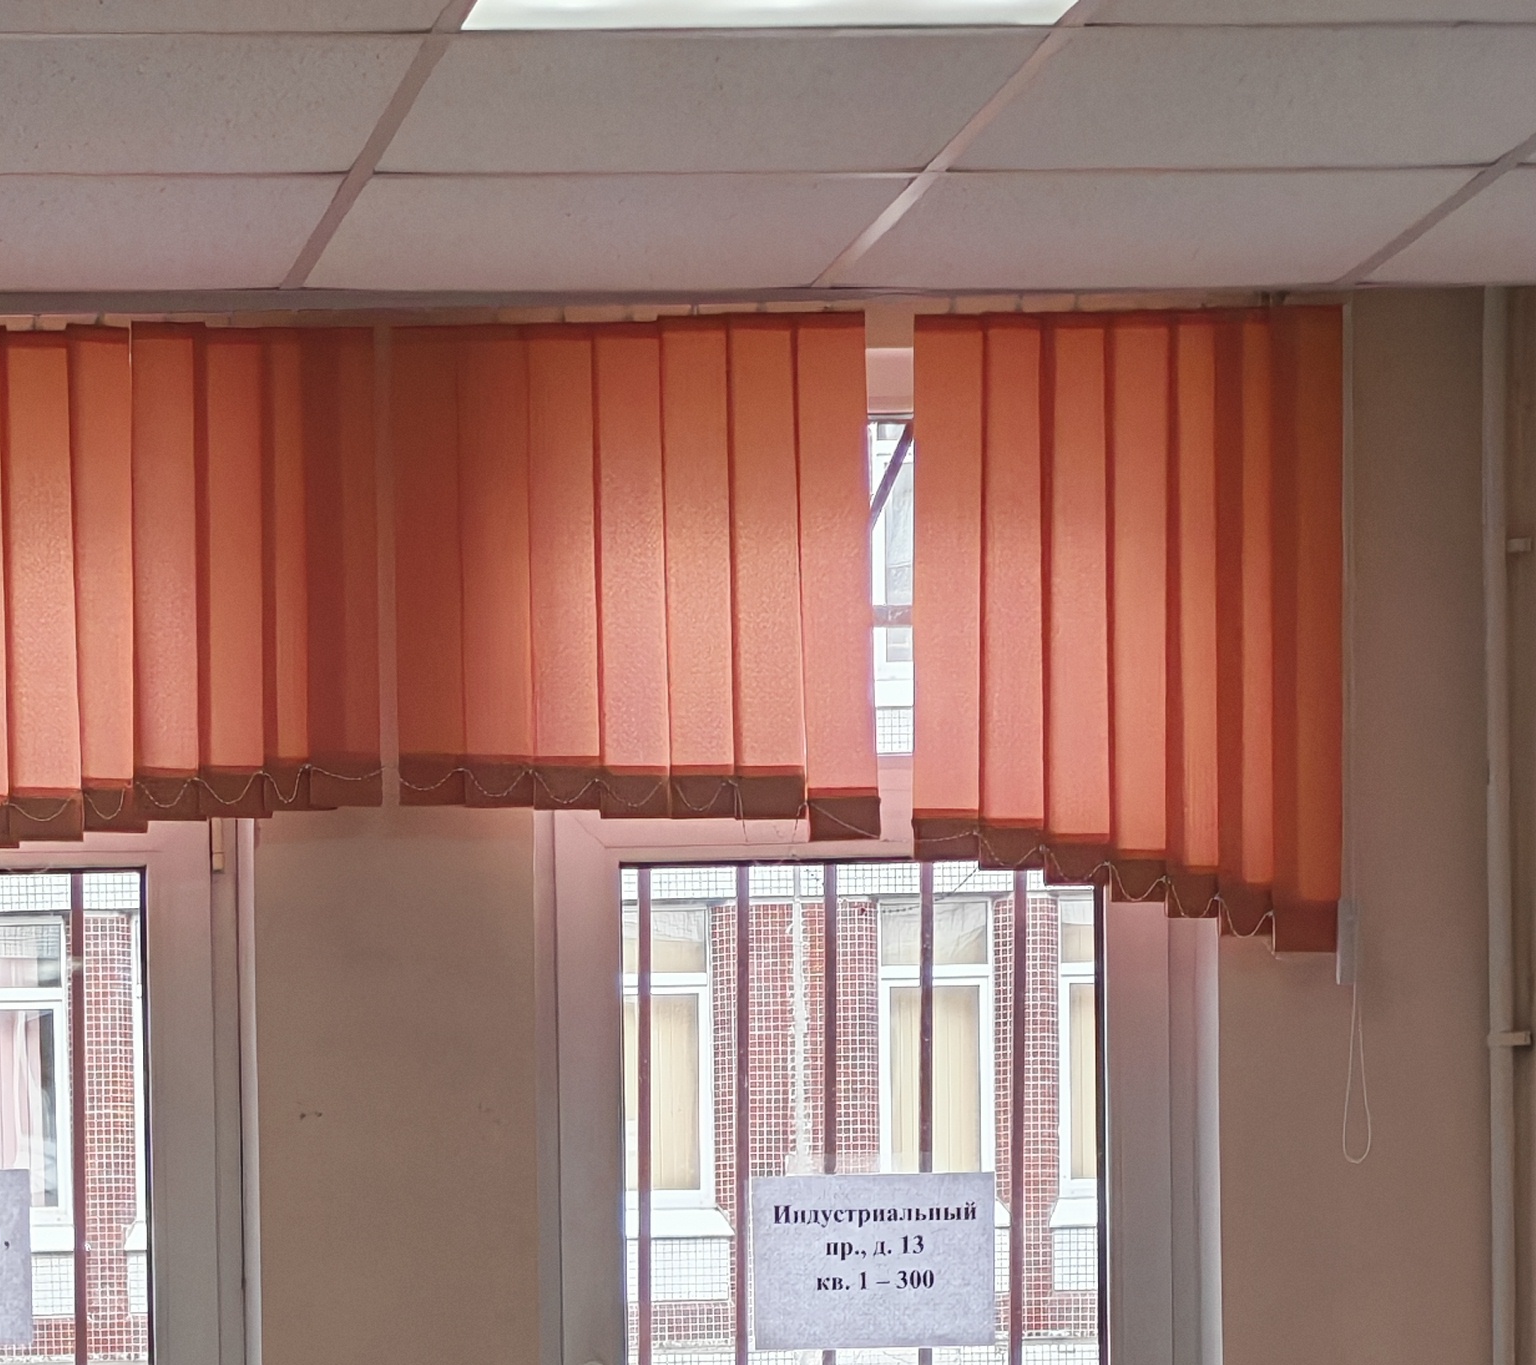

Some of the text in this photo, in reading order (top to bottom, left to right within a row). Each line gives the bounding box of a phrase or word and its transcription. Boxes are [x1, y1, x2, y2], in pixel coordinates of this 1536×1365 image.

[773, 1202, 977, 1227] Индустриальный
[826, 1235, 925, 1260] пр., д. 13
[816, 1276, 850, 1291] кв.
[859, 1271, 867, 1290] 1
[896, 1270, 935, 1289] 300
